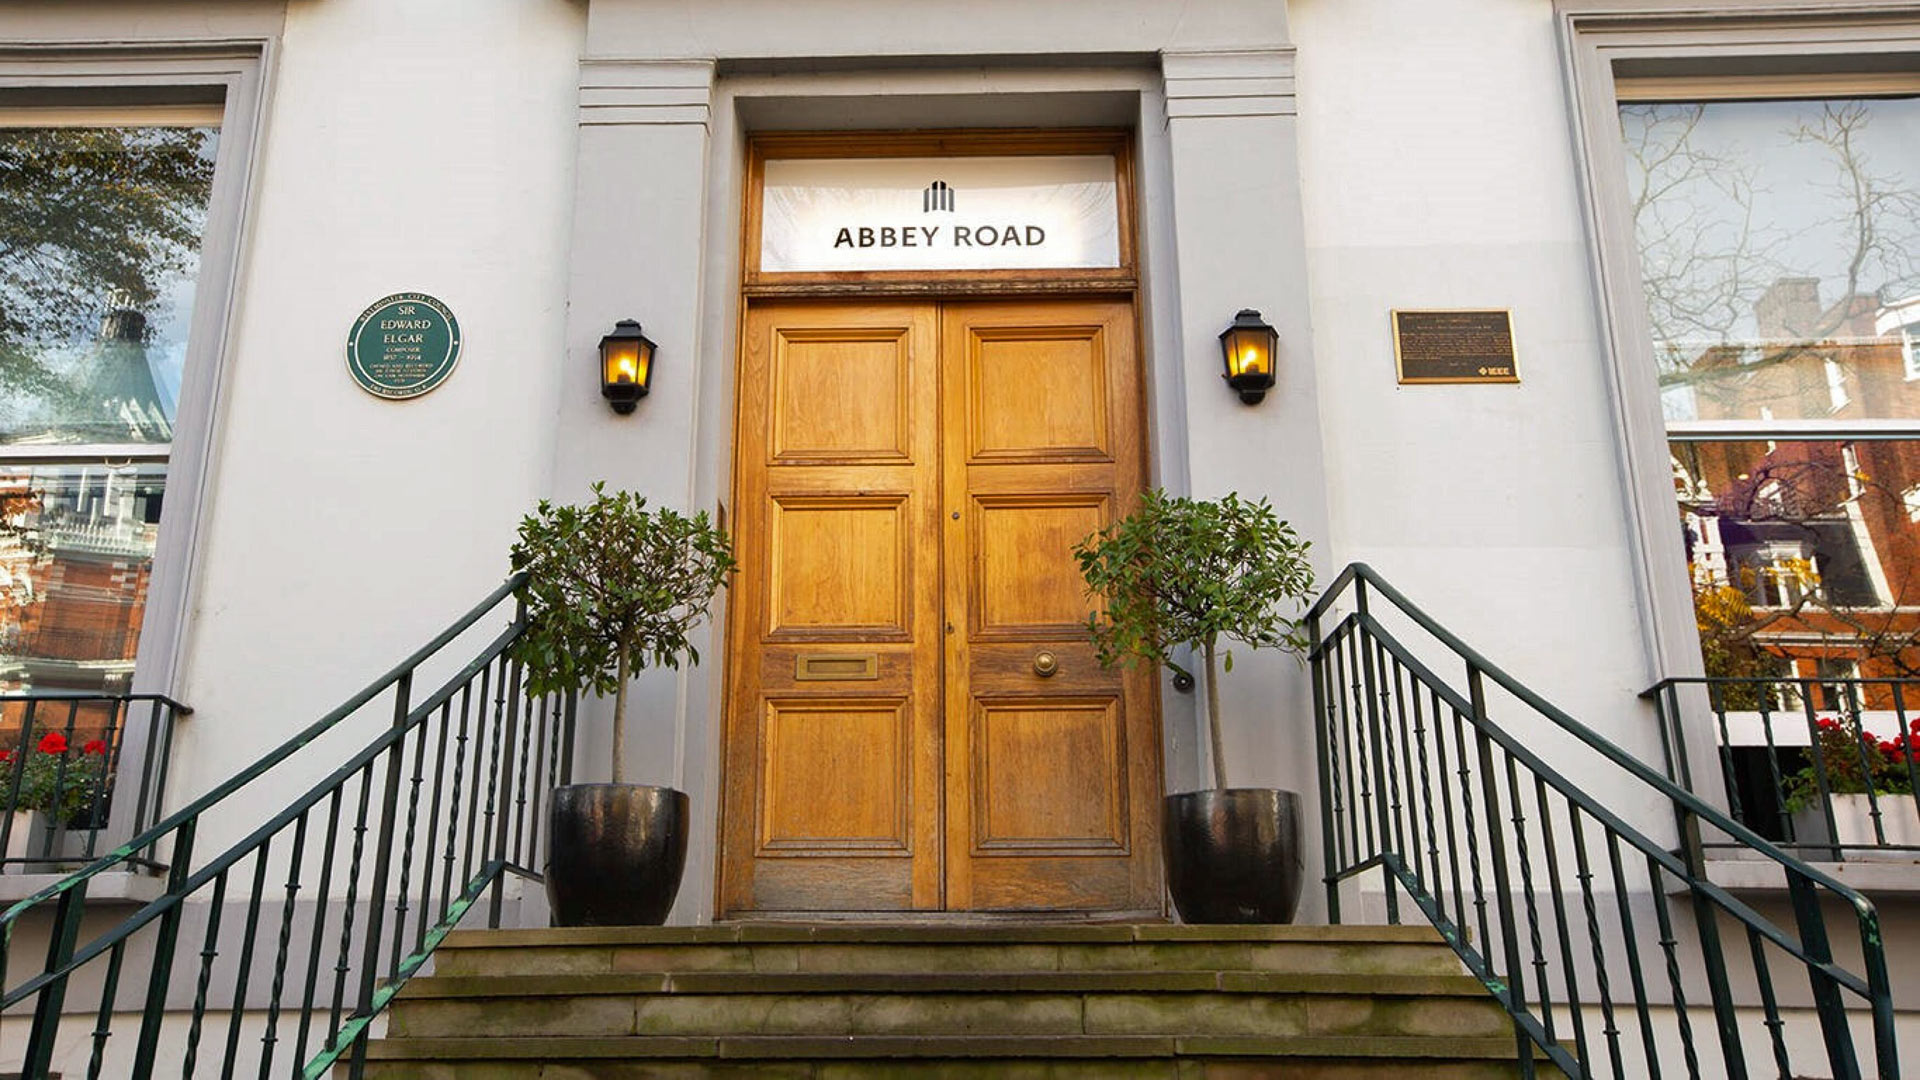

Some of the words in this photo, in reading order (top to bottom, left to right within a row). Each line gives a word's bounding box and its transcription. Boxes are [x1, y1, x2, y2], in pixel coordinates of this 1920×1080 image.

[834, 226, 940, 249] ABBEY
[953, 225, 1046, 247] ROAD
[398, 305, 416, 315] SIR
[380, 320, 431, 329] EDWARD
[384, 334, 423, 343] ELGAR
[1487, 367, 1510, 375] IEEE
